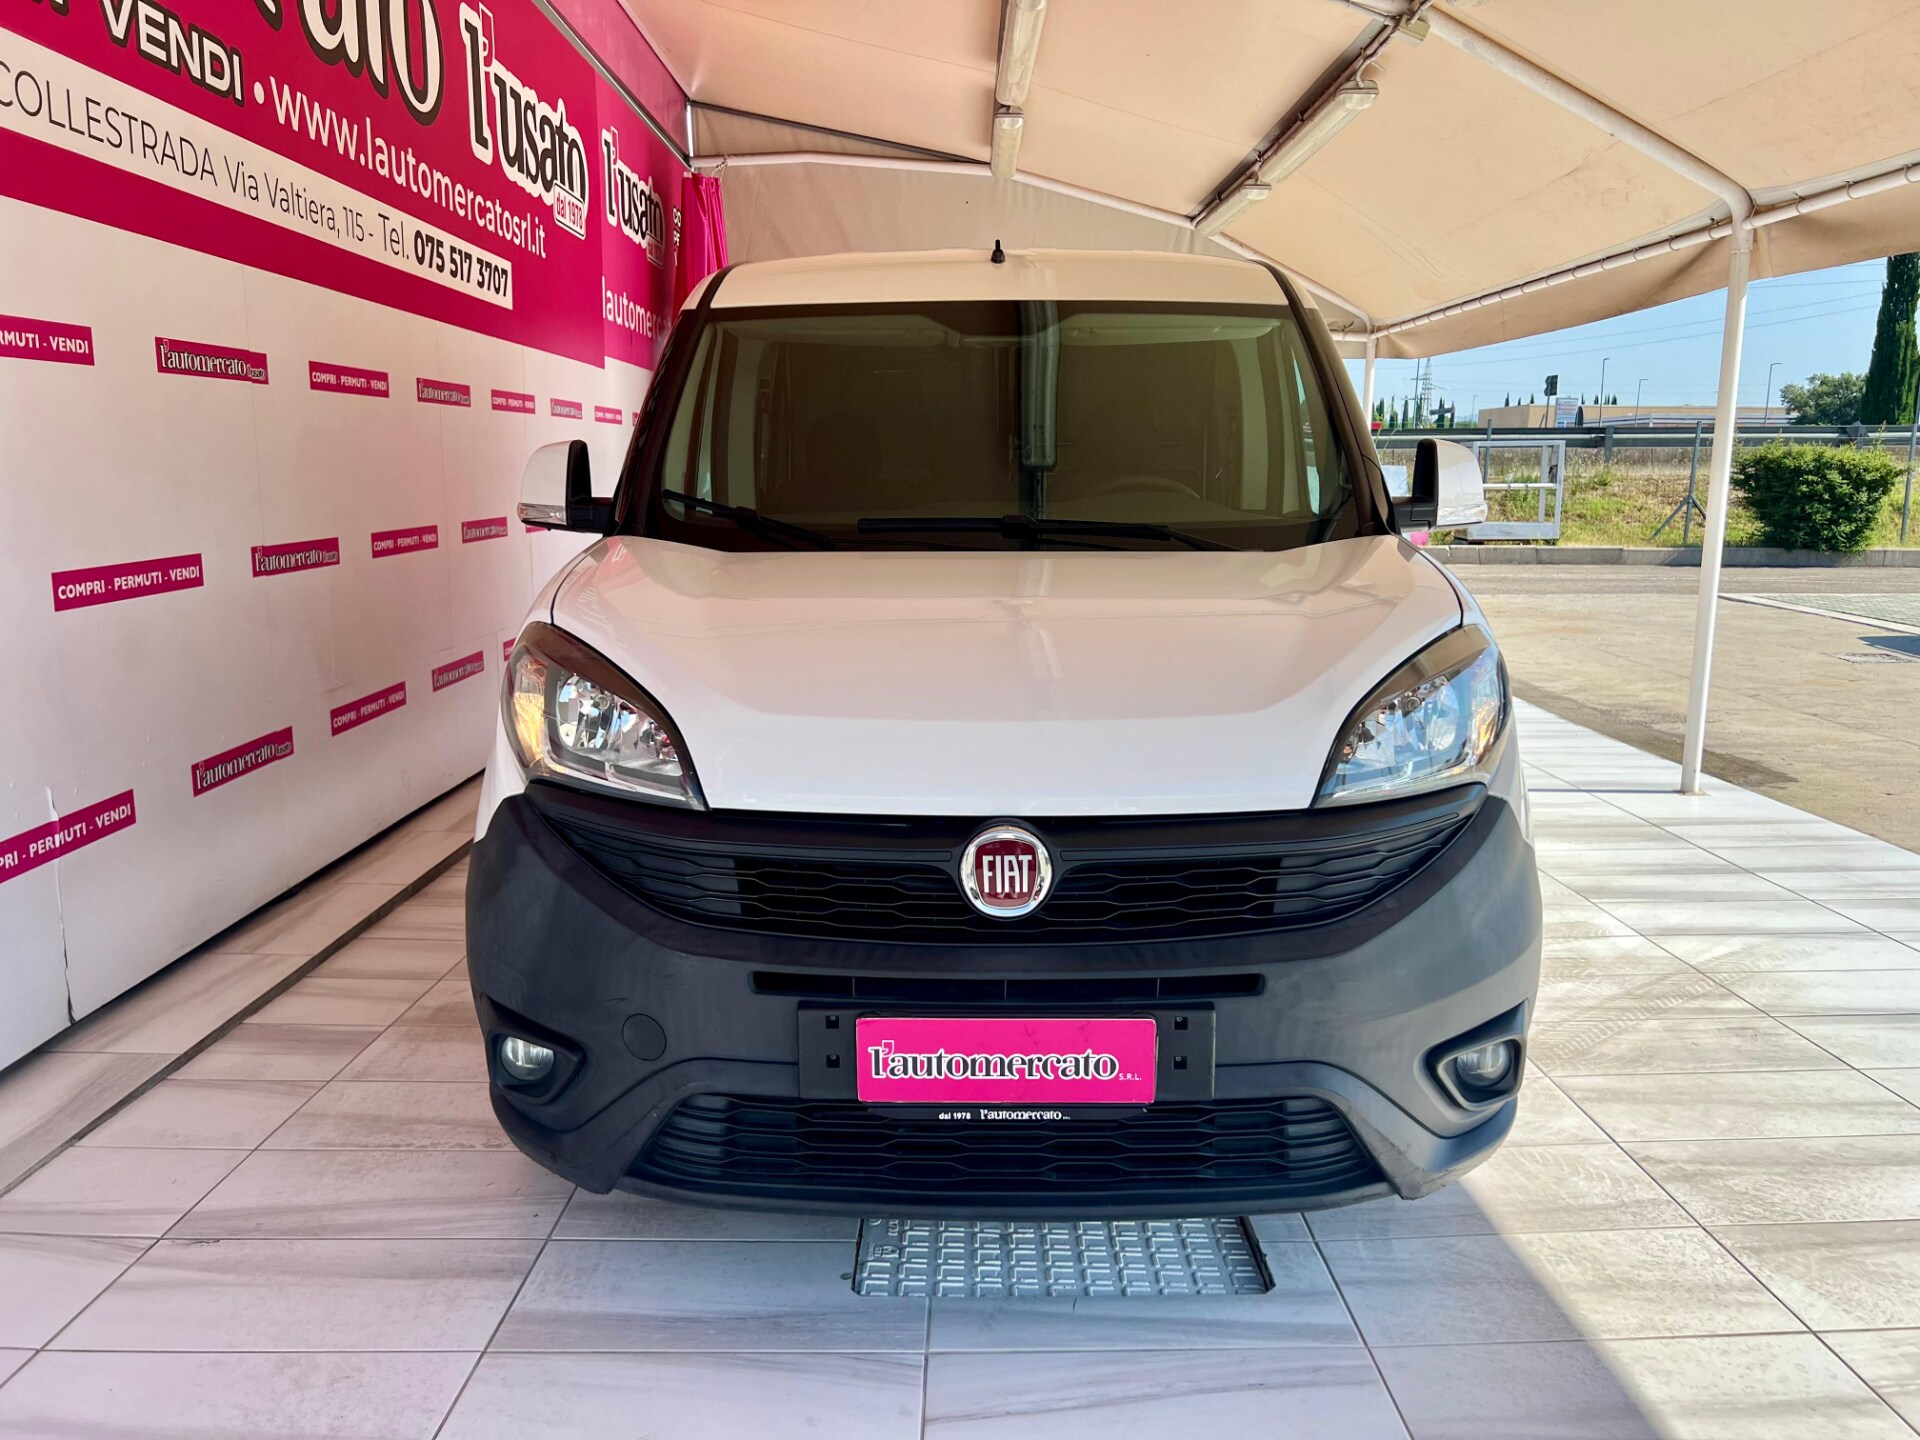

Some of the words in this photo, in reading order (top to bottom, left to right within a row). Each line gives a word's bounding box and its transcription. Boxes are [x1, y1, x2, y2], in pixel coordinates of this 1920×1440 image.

[100, 0, 243, 104] VENDI
[268, 75, 547, 259] www.lautomercatosrl.it
[223, 155, 260, 203] Via
[263, 172, 341, 239] Valtiera,
[342, 206, 365, 242] 115
[377, 212, 410, 260] Tel.
[413, 229, 446, 274] 075
[449, 244, 473, 284] 517
[476, 256, 509, 298] 3707
[556, 191, 567, 221] dal
[567, 200, 583, 231] 1978
[49, 335, 90, 355] VENDI
[159, 339, 248, 377] l'automercato
[311, 371, 337, 385] COMPRI
[340, 375, 368, 389] PERMUTI
[370, 379, 388, 392] VENDI
[254, 546, 323, 572] l'automercato
[373, 540, 394, 551] COMPRI
[57, 579, 106, 600] COMPRI
[113, 571, 163, 592] PERMUTI
[169, 565, 200, 583] VENDI
[332, 713, 357, 729] COMPRI
[360, 698, 386, 717] PERMUTI
[195, 744, 276, 790] l'automercato
[95, 803, 132, 830] VENDI
[982, 855, 1033, 894] FIAT
[868, 1039, 1119, 1080] l'automercato
[1118, 1072, 1143, 1081] S.R.L.
[938, 1111, 952, 1120] dal
[952, 1111, 972, 1120] 1978
[979, 1108, 1063, 1121] l'automercato
